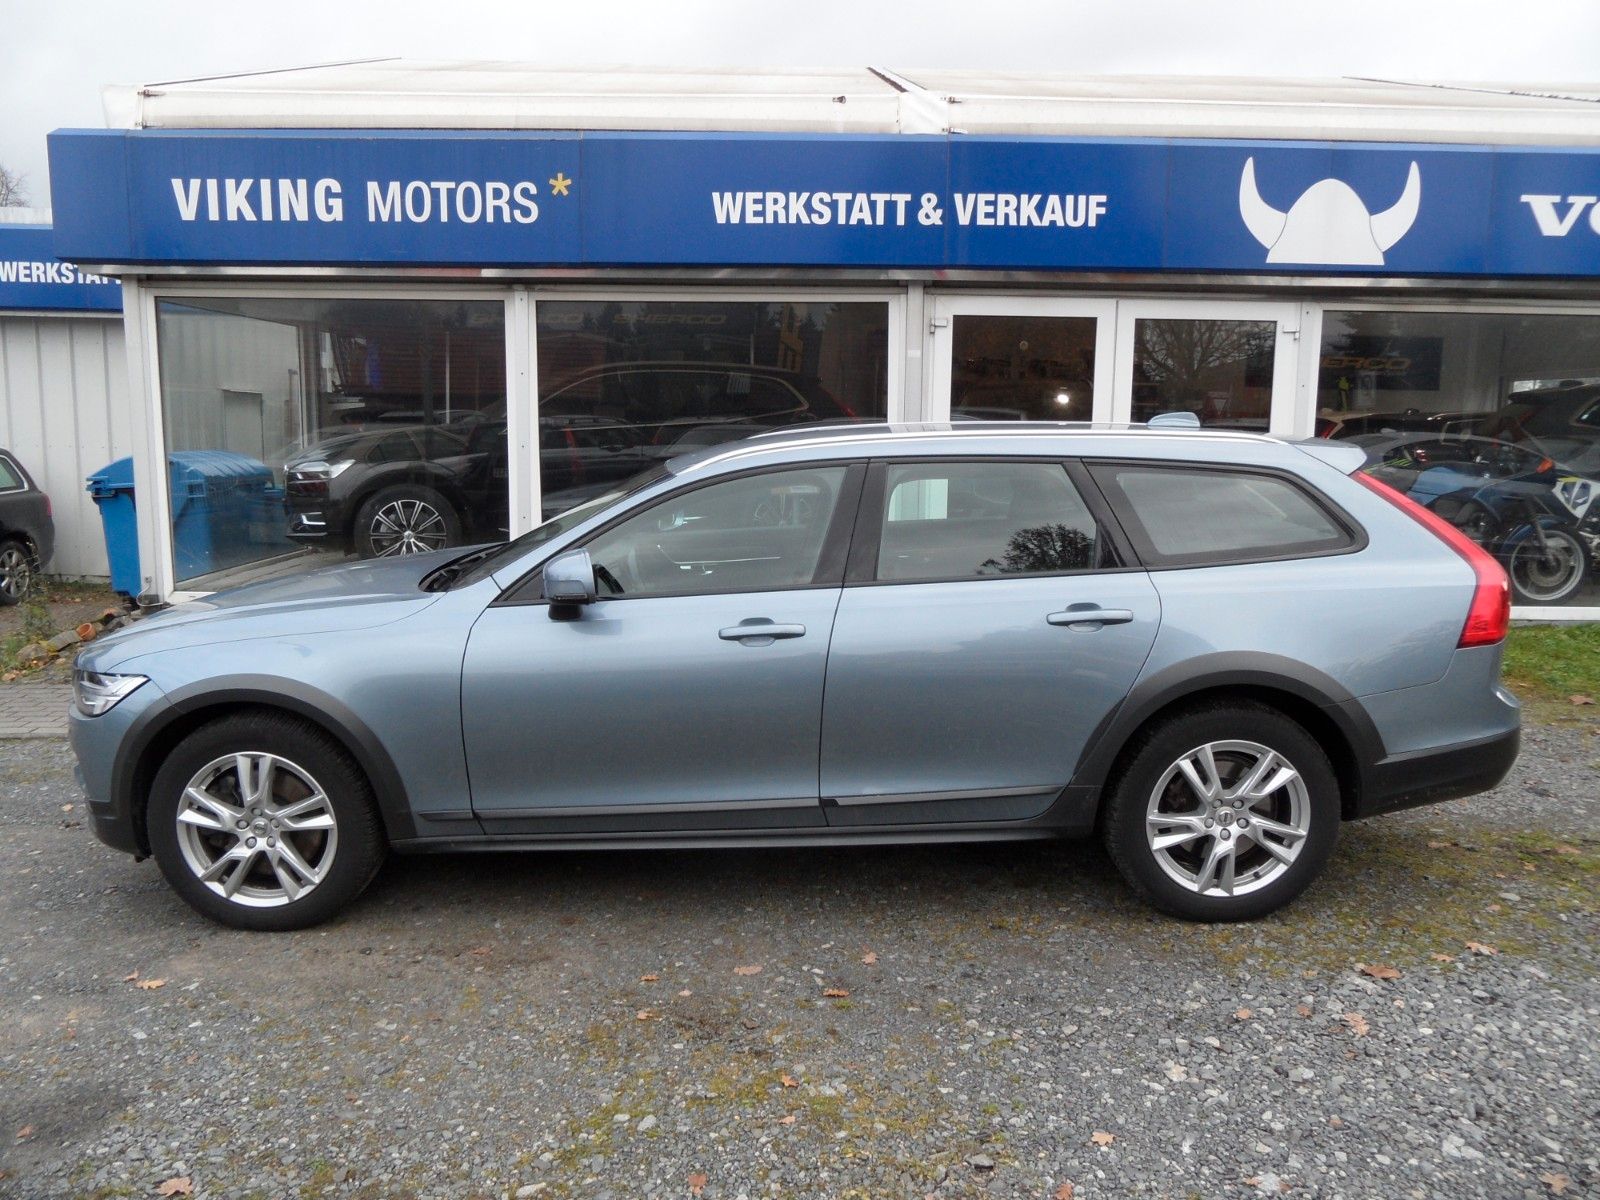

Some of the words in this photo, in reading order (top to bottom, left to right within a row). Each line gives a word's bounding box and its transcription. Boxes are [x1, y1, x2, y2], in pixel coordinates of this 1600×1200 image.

[170, 178, 343, 222] VIKING
[366, 180, 539, 224] MOTORS
[711, 191, 911, 226] WERKSTATT
[917, 192, 943, 226] &
[953, 193, 1108, 227] VERKAUF
[1520, 194, 1600, 237] V
[0, 261, 121, 284] WERKS
